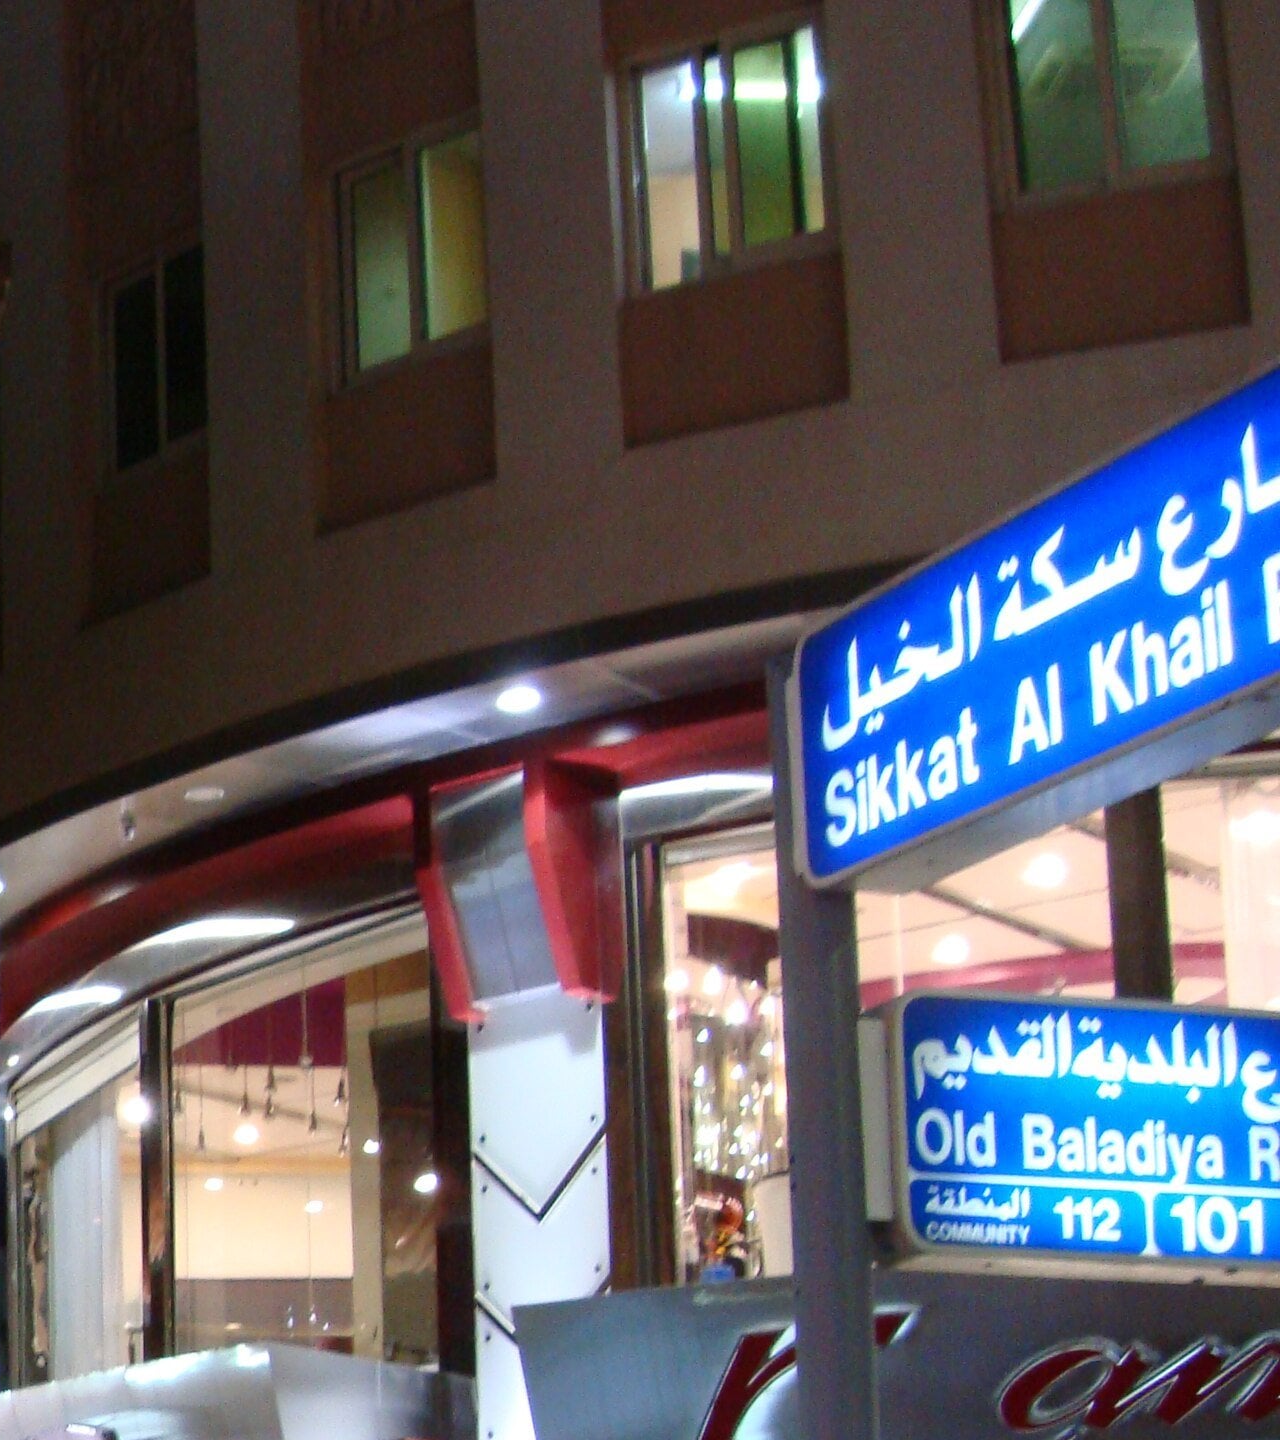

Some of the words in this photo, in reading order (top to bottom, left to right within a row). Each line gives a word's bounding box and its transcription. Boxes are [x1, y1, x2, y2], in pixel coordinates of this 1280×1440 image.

[992, 525, 1143, 642] سكة
[821, 572, 981, 752] الخيل
[824, 706, 981, 848] Sikkat
[1008, 663, 1063, 766] Al
[1088, 579, 1235, 727] Khail
[911, 1009, 1073, 1101] القديم
[1070, 1015, 1238, 1104] البلدية
[915, 1107, 996, 1168] Old
[1020, 1113, 1225, 1185] Baladiya
[925, 1183, 1031, 1221] المنطقة
[925, 1223, 1030, 1245] COMMUNITY
[1053, 1195, 1122, 1242] 112
[1170, 1195, 1265, 1256] 101
